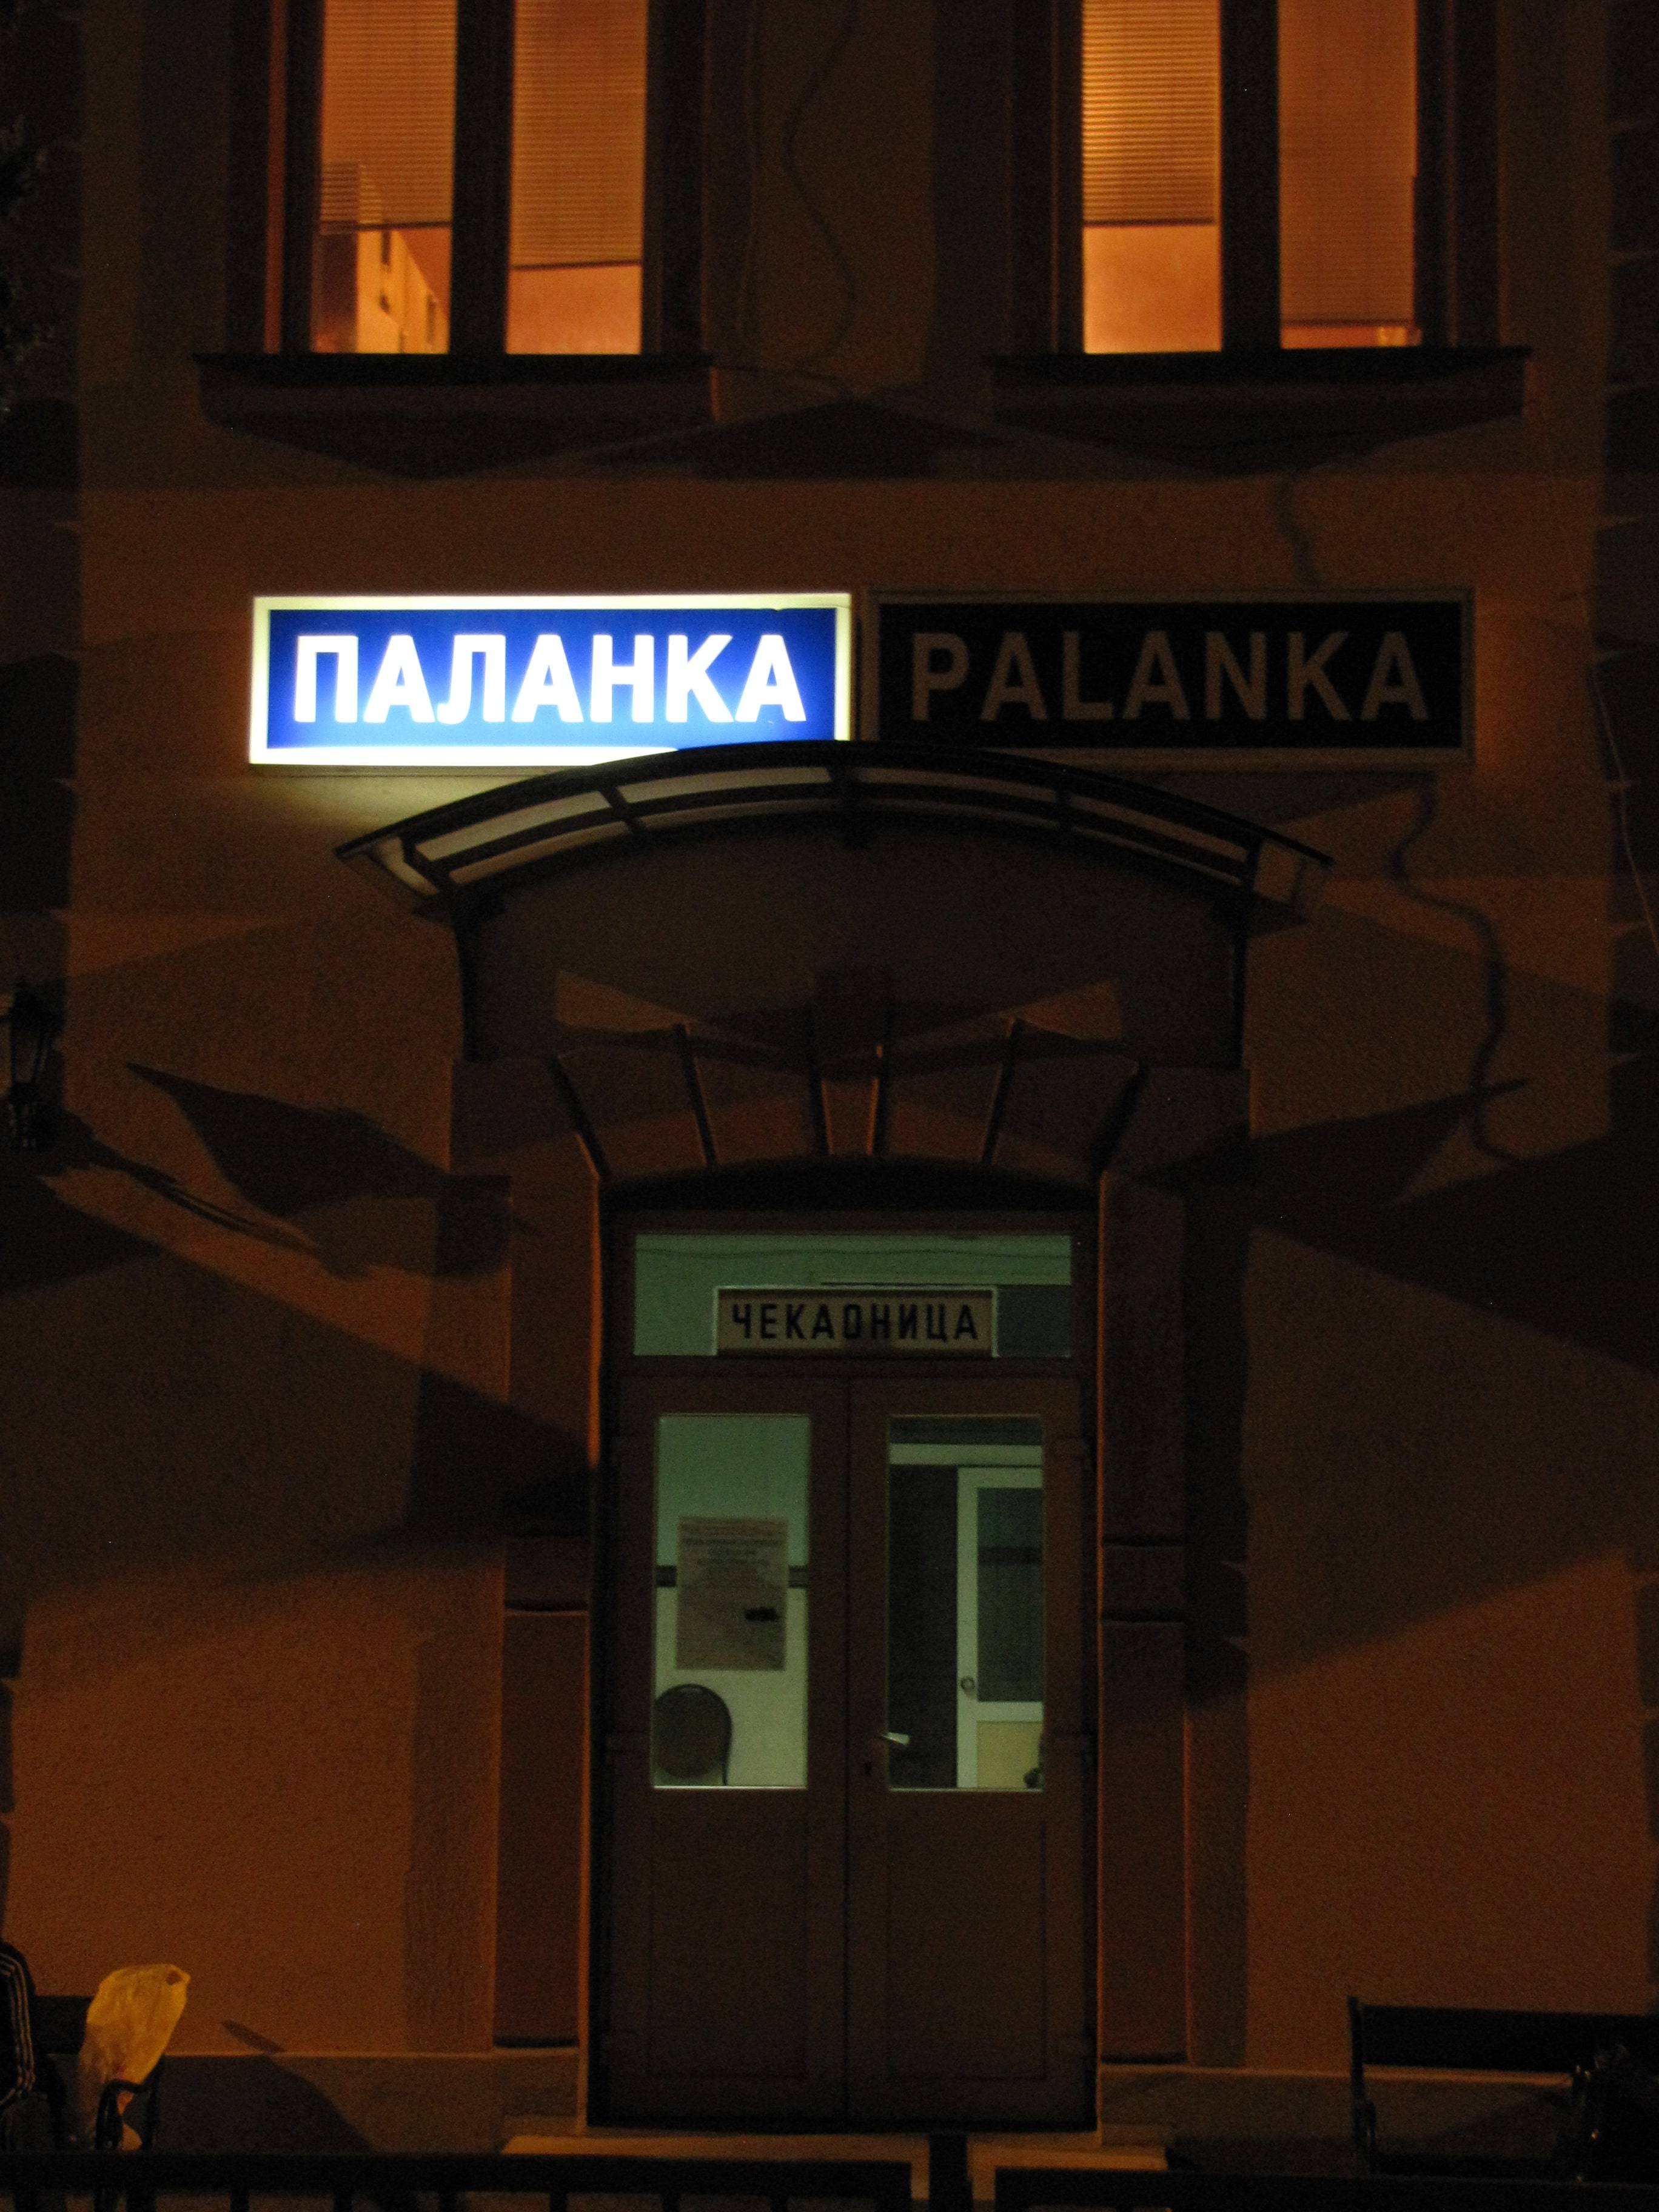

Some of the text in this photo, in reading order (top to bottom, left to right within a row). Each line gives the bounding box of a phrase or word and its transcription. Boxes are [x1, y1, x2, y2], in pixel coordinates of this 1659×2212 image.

[293, 634, 808, 725] ПАЛАНКА
[911, 630, 1430, 722] PALANKA
[732, 1303, 977, 1342] ЧЕКАОНИЦА
